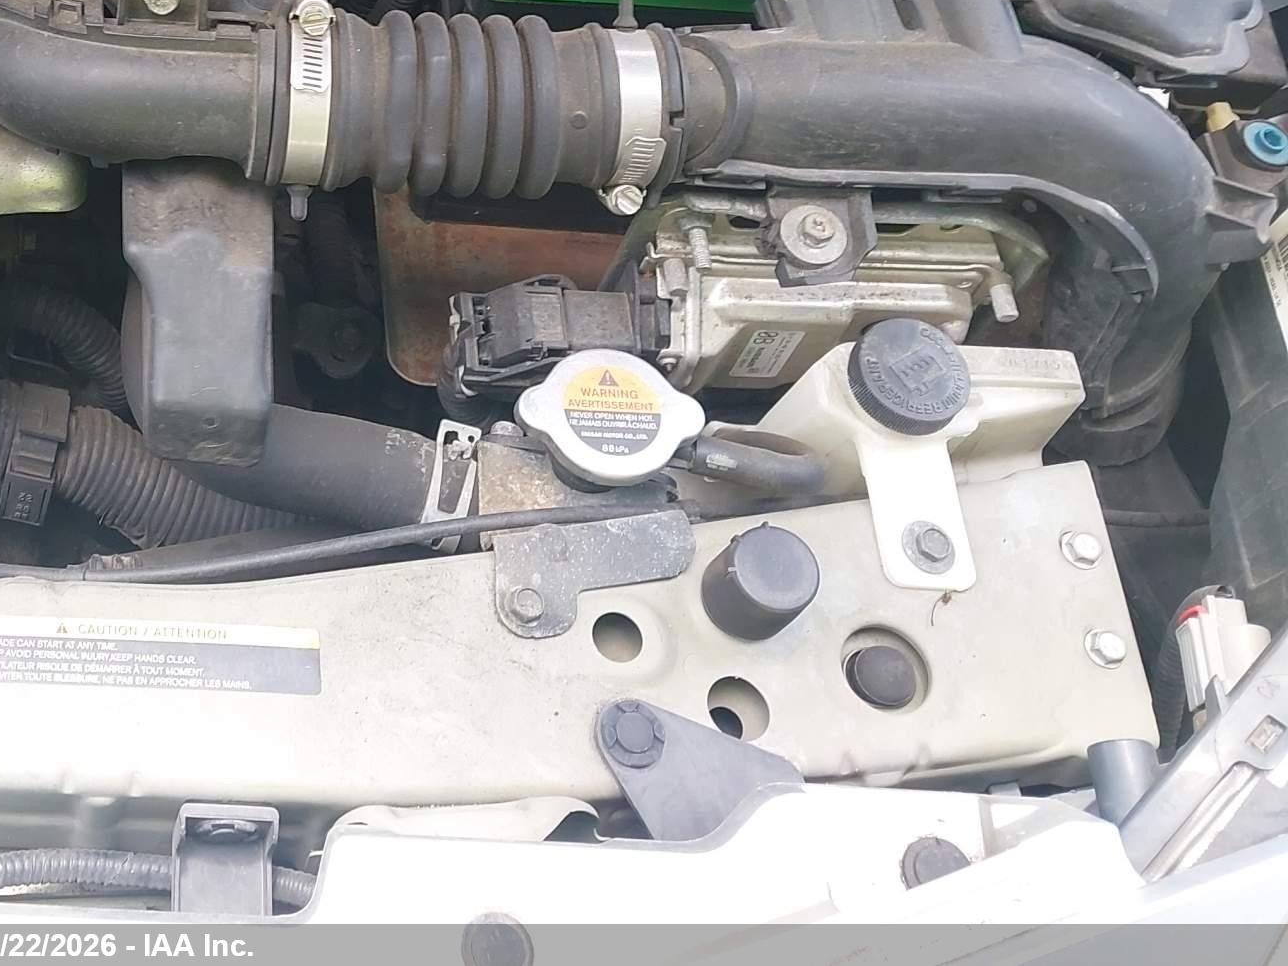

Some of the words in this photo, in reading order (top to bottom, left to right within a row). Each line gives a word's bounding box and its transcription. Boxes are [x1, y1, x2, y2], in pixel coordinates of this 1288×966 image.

[580, 387, 639, 400] WARNING
[568, 399, 654, 411] AVERTISSEMENT
[570, 411, 592, 419] NEVER
[594, 412, 614, 420] OPEN
[579, 419, 601, 427] JAMAIS
[78, 624, 137, 636] CAUTION
[153, 627, 227, 640] ATTENTION
[16, 638, 35, 647] CAN
[37, 640, 64, 649] START
[65, 641, 75, 649] AT
[77, 641, 95, 650] ANY
[97, 642, 118, 651] TIME.
[5, 649, 32, 658] AVOID
[33, 650, 80, 661] PERSONAL
[134, 654, 164, 663] HANDS
[36, 662, 69, 672] RISQUE
[70, 663, 83, 672] DE
[84, 663, 132, 674] DÉMARRER
[142, 666, 163, 675] TOUT
[24, 672, 53, 682] TOUTE
[102, 675, 114, 684] NE
[116, 675, 133, 685] PAS
[135, 676, 147, 685] EN
[149, 677, 202, 687] APPROCHER
[204, 679, 220, 688] LES
